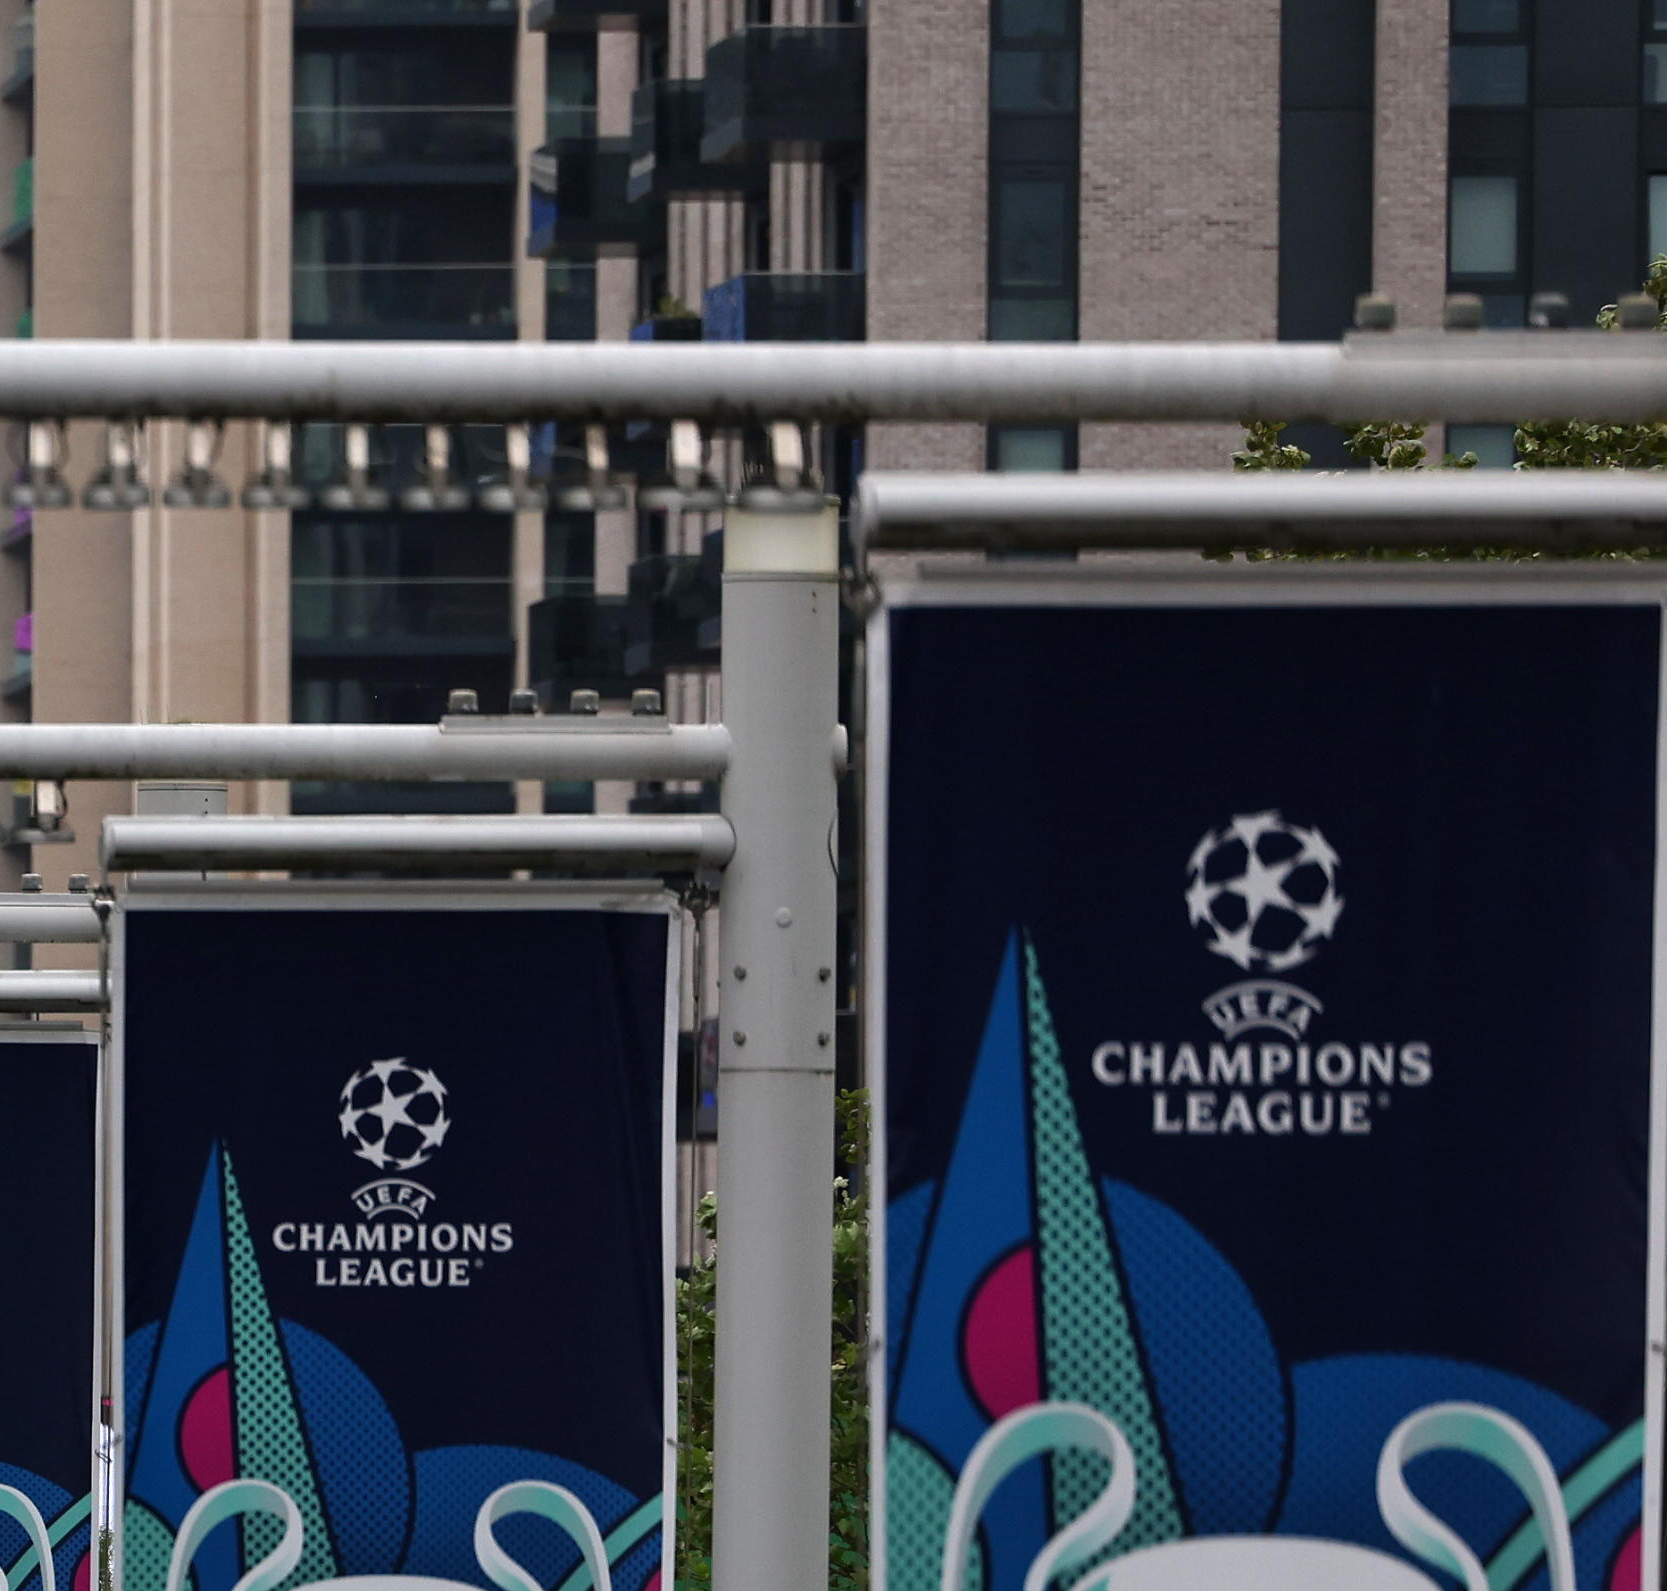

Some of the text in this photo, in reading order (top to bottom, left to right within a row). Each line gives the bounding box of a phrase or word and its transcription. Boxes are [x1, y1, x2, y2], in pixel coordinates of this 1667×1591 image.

[1205, 990, 1312, 1034] UEFA
[1091, 1040, 1434, 1087] CHAMPIONS
[1152, 1091, 1372, 1135] LEAGUE
[356, 1185, 428, 1214] UEFA
[271, 1222, 514, 1252] CHAMPIONS
[315, 1257, 471, 1287] LEAGUE
